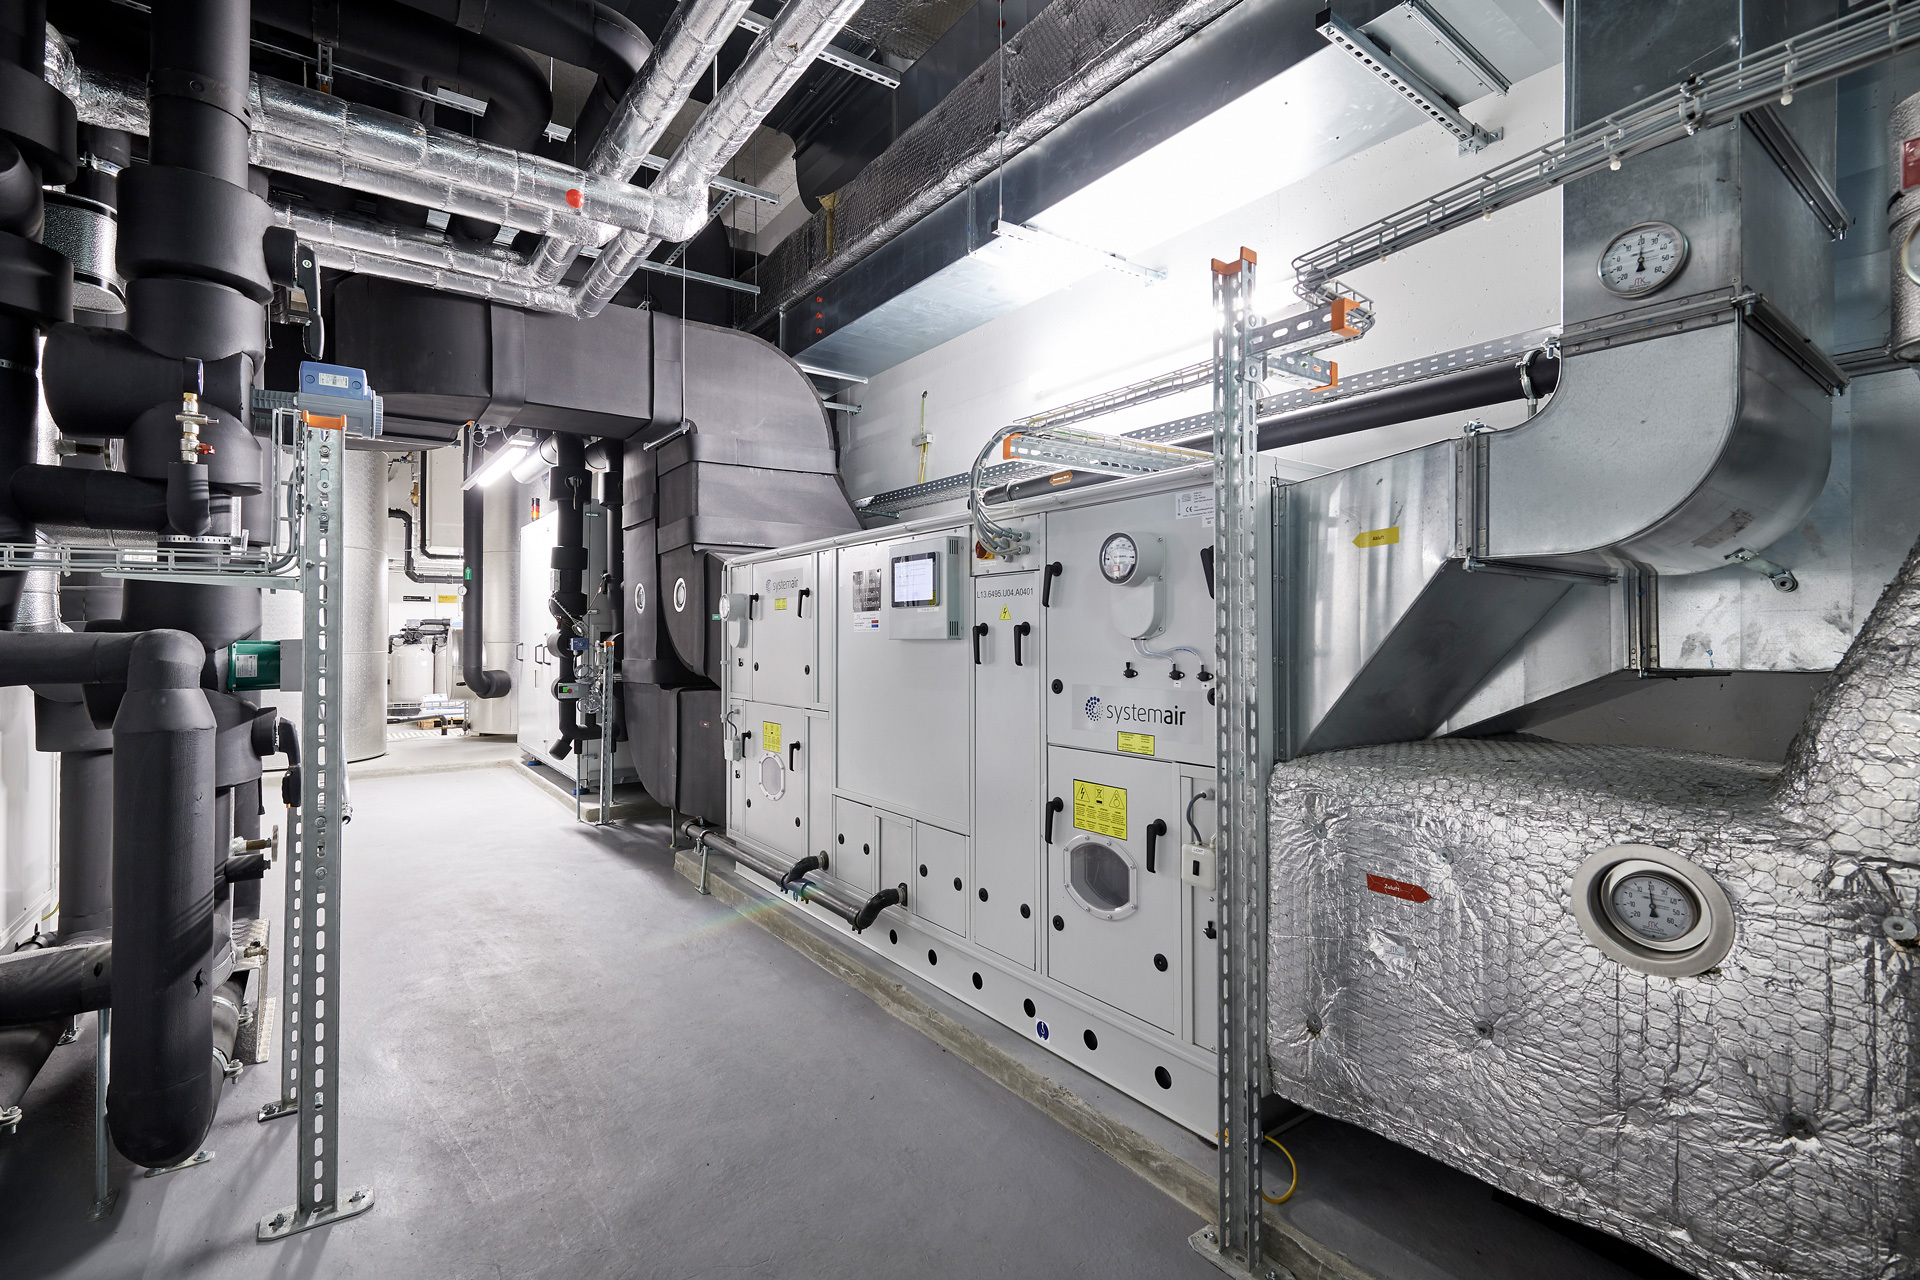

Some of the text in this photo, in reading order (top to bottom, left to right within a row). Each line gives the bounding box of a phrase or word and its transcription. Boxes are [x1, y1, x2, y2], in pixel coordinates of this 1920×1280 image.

[772, 577, 799, 593] systemair
[977, 588, 1034, 599] L13.6495.U04.A0401
[1106, 704, 1187, 726] systemair
